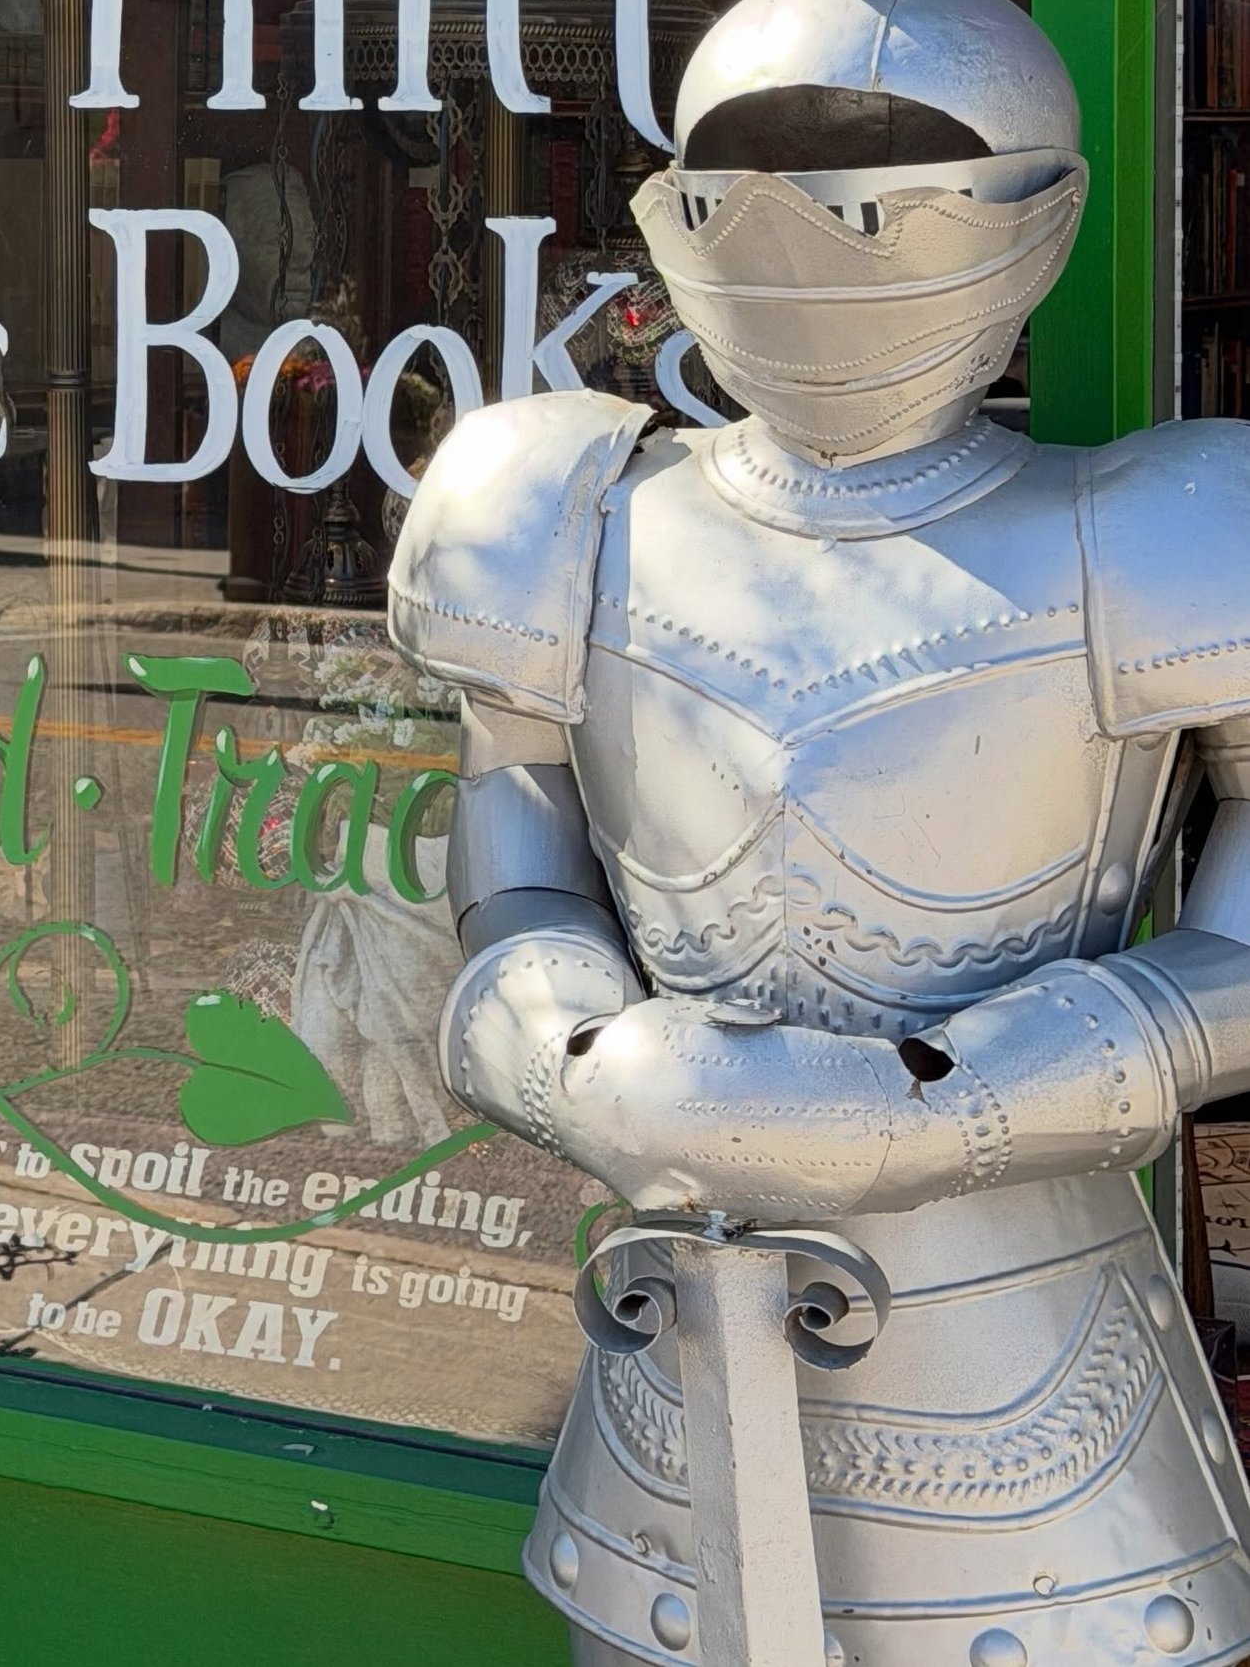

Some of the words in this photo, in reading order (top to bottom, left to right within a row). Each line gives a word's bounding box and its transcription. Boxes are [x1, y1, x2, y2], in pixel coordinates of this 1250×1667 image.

[14, 1143, 51, 1179] to
[66, 1141, 211, 1198] spoil
[222, 1165, 289, 1207] the
[302, 1171, 534, 1248] ending,
[26, 1292, 66, 1331] to
[72, 1300, 122, 1338] be
[137, 1287, 341, 1372] OKAY.
[351, 1254, 393, 1295] is
[398, 1265, 531, 1323] going
